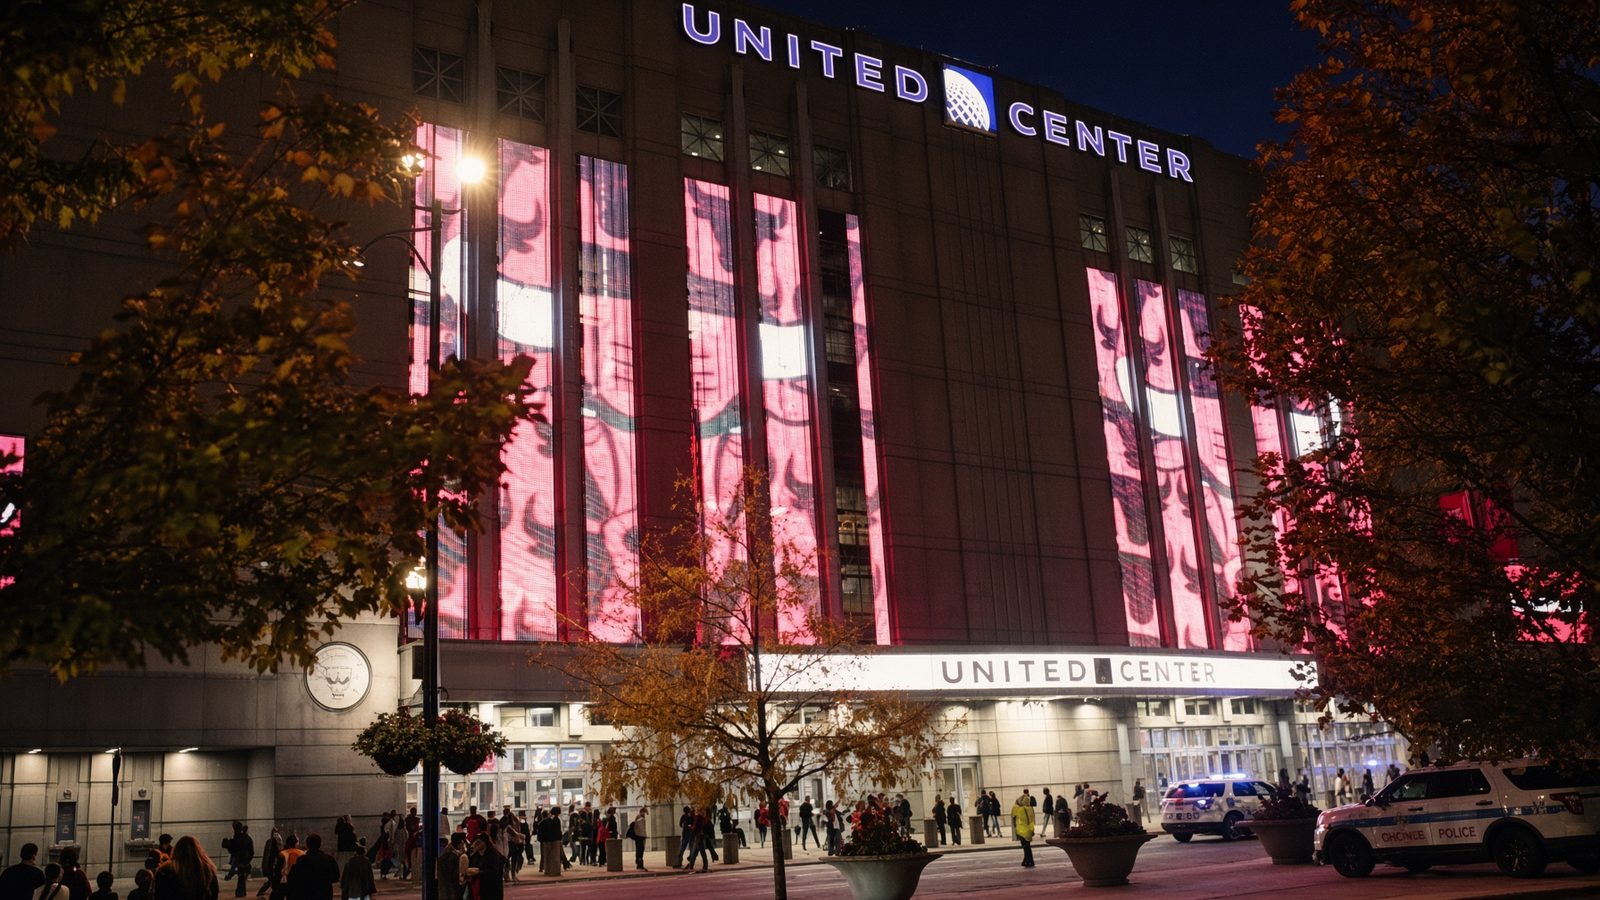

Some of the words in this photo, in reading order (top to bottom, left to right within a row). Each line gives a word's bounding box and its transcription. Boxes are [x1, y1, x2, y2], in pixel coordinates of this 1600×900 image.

[682, 2, 929, 103] UNITED
[1008, 102, 1194, 183] CENTER
[941, 659, 1086, 684] UNITED
[1120, 659, 1217, 683] CENTER
[1438, 826, 1477, 839] POLICE
